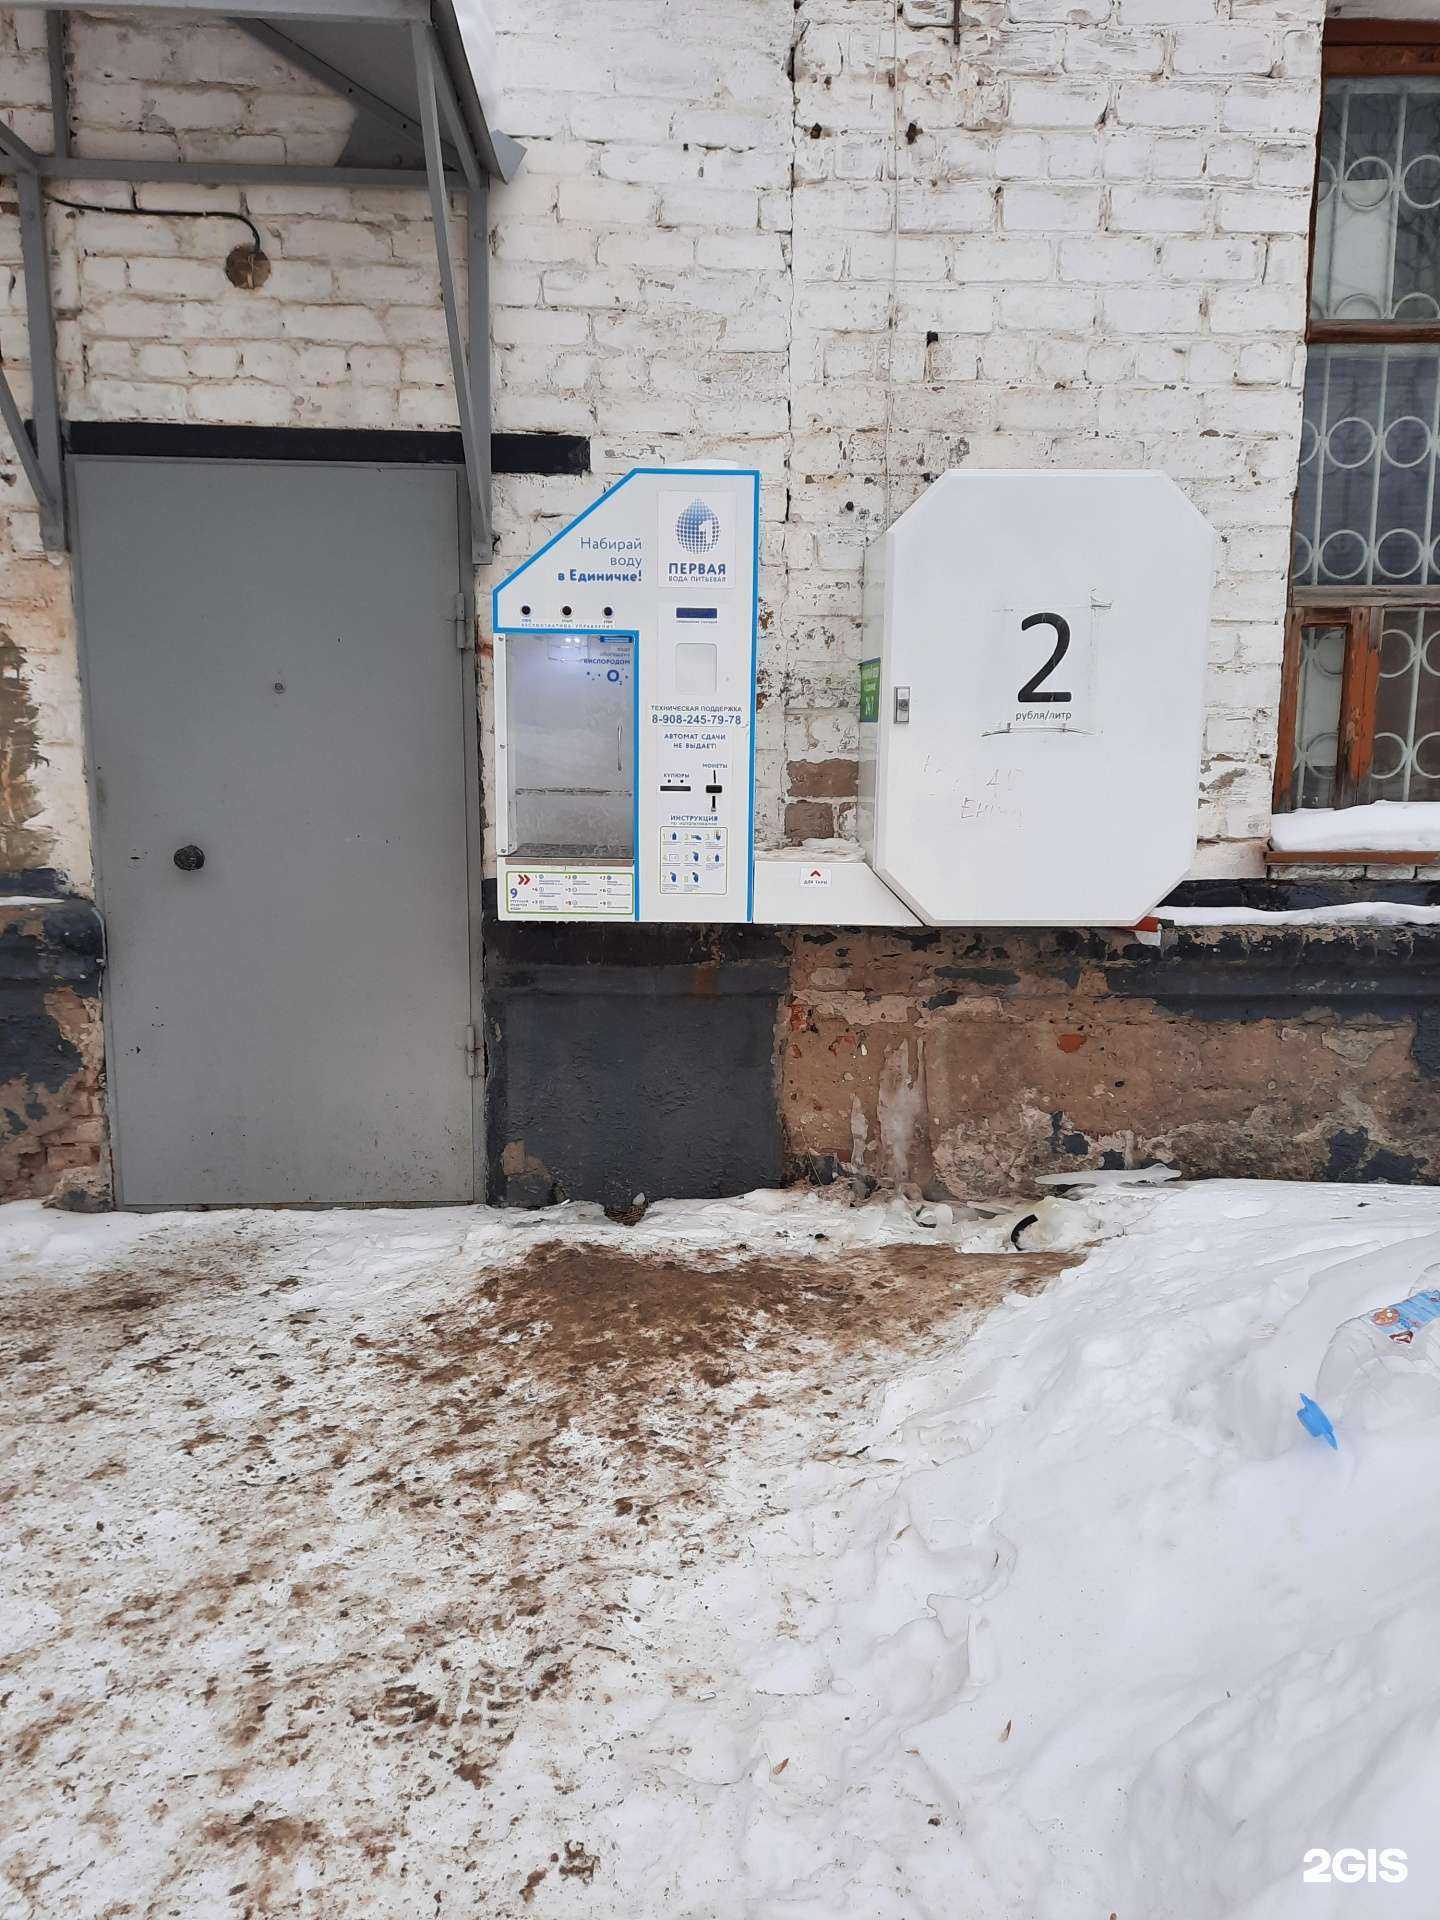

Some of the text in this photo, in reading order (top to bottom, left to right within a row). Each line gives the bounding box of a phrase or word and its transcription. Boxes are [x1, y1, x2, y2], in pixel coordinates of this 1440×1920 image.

[580, 537, 642, 552] Набирай
[610, 556, 642, 568] воду
[668, 562, 727, 575] ПЕРВАЯ
[557, 569, 642, 582] в Единичке!
[668, 575, 726, 583] ВОДА ПИТЬЕВАЯ
[1017, 612, 1072, 703] 2
[700, 705, 743, 713] ПОДДЕРЖКА
[651, 714, 742, 725] 8-908-245-79-78
[1015, 710, 1072, 722] рубля/литр
[701, 733, 726, 741] СДАЧИ
[510, 887, 518, 899] 9
